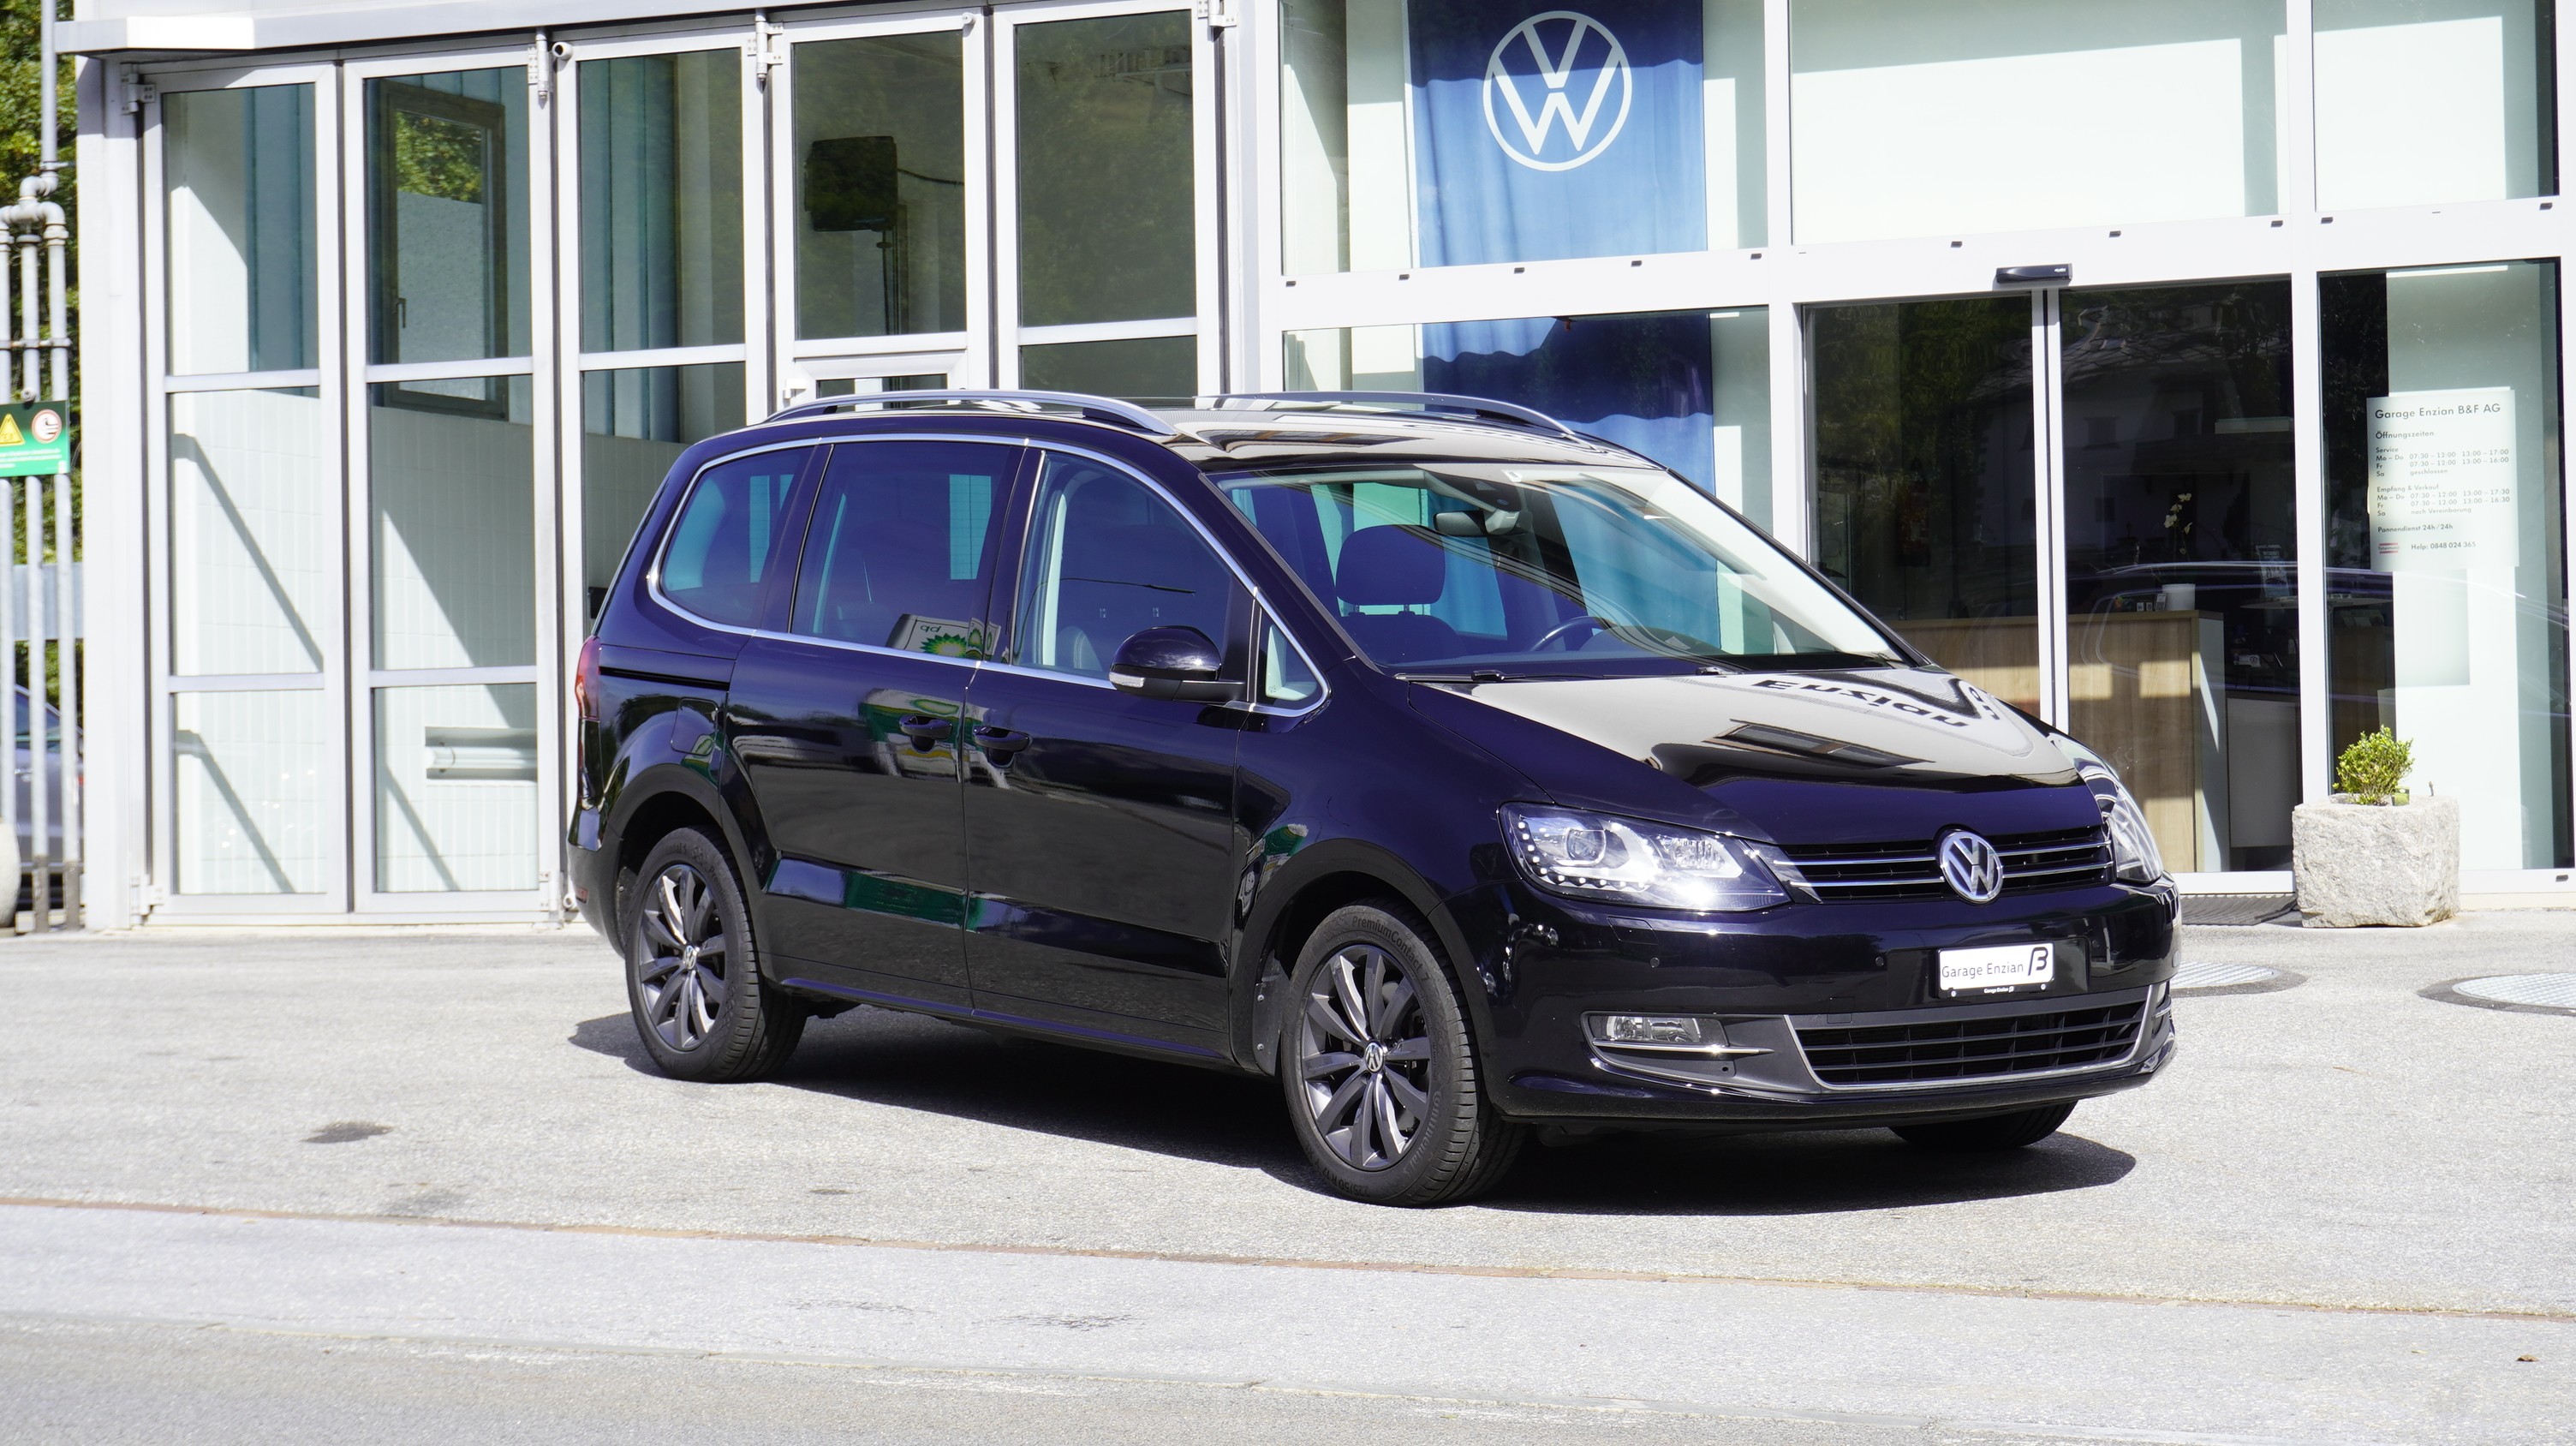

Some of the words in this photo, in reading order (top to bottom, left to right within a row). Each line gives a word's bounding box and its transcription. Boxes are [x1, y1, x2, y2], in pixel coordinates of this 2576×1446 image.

[1486, 13, 1630, 166] VW
[2375, 409, 2415, 420] Garage
[2419, 407, 2454, 416] Enzian
[2458, 404, 2478, 415] B&F
[2484, 403, 2501, 413] AG
[2376, 431, 2435, 439] Öffnungszeiten
[1941, 832, 2002, 902] VW
[1352, 915, 1423, 972] PremiumContact
[1941, 965, 1983, 979] Garage
[1986, 961, 2024, 975] Enzian
[1408, 1090, 1442, 1168] Continental
